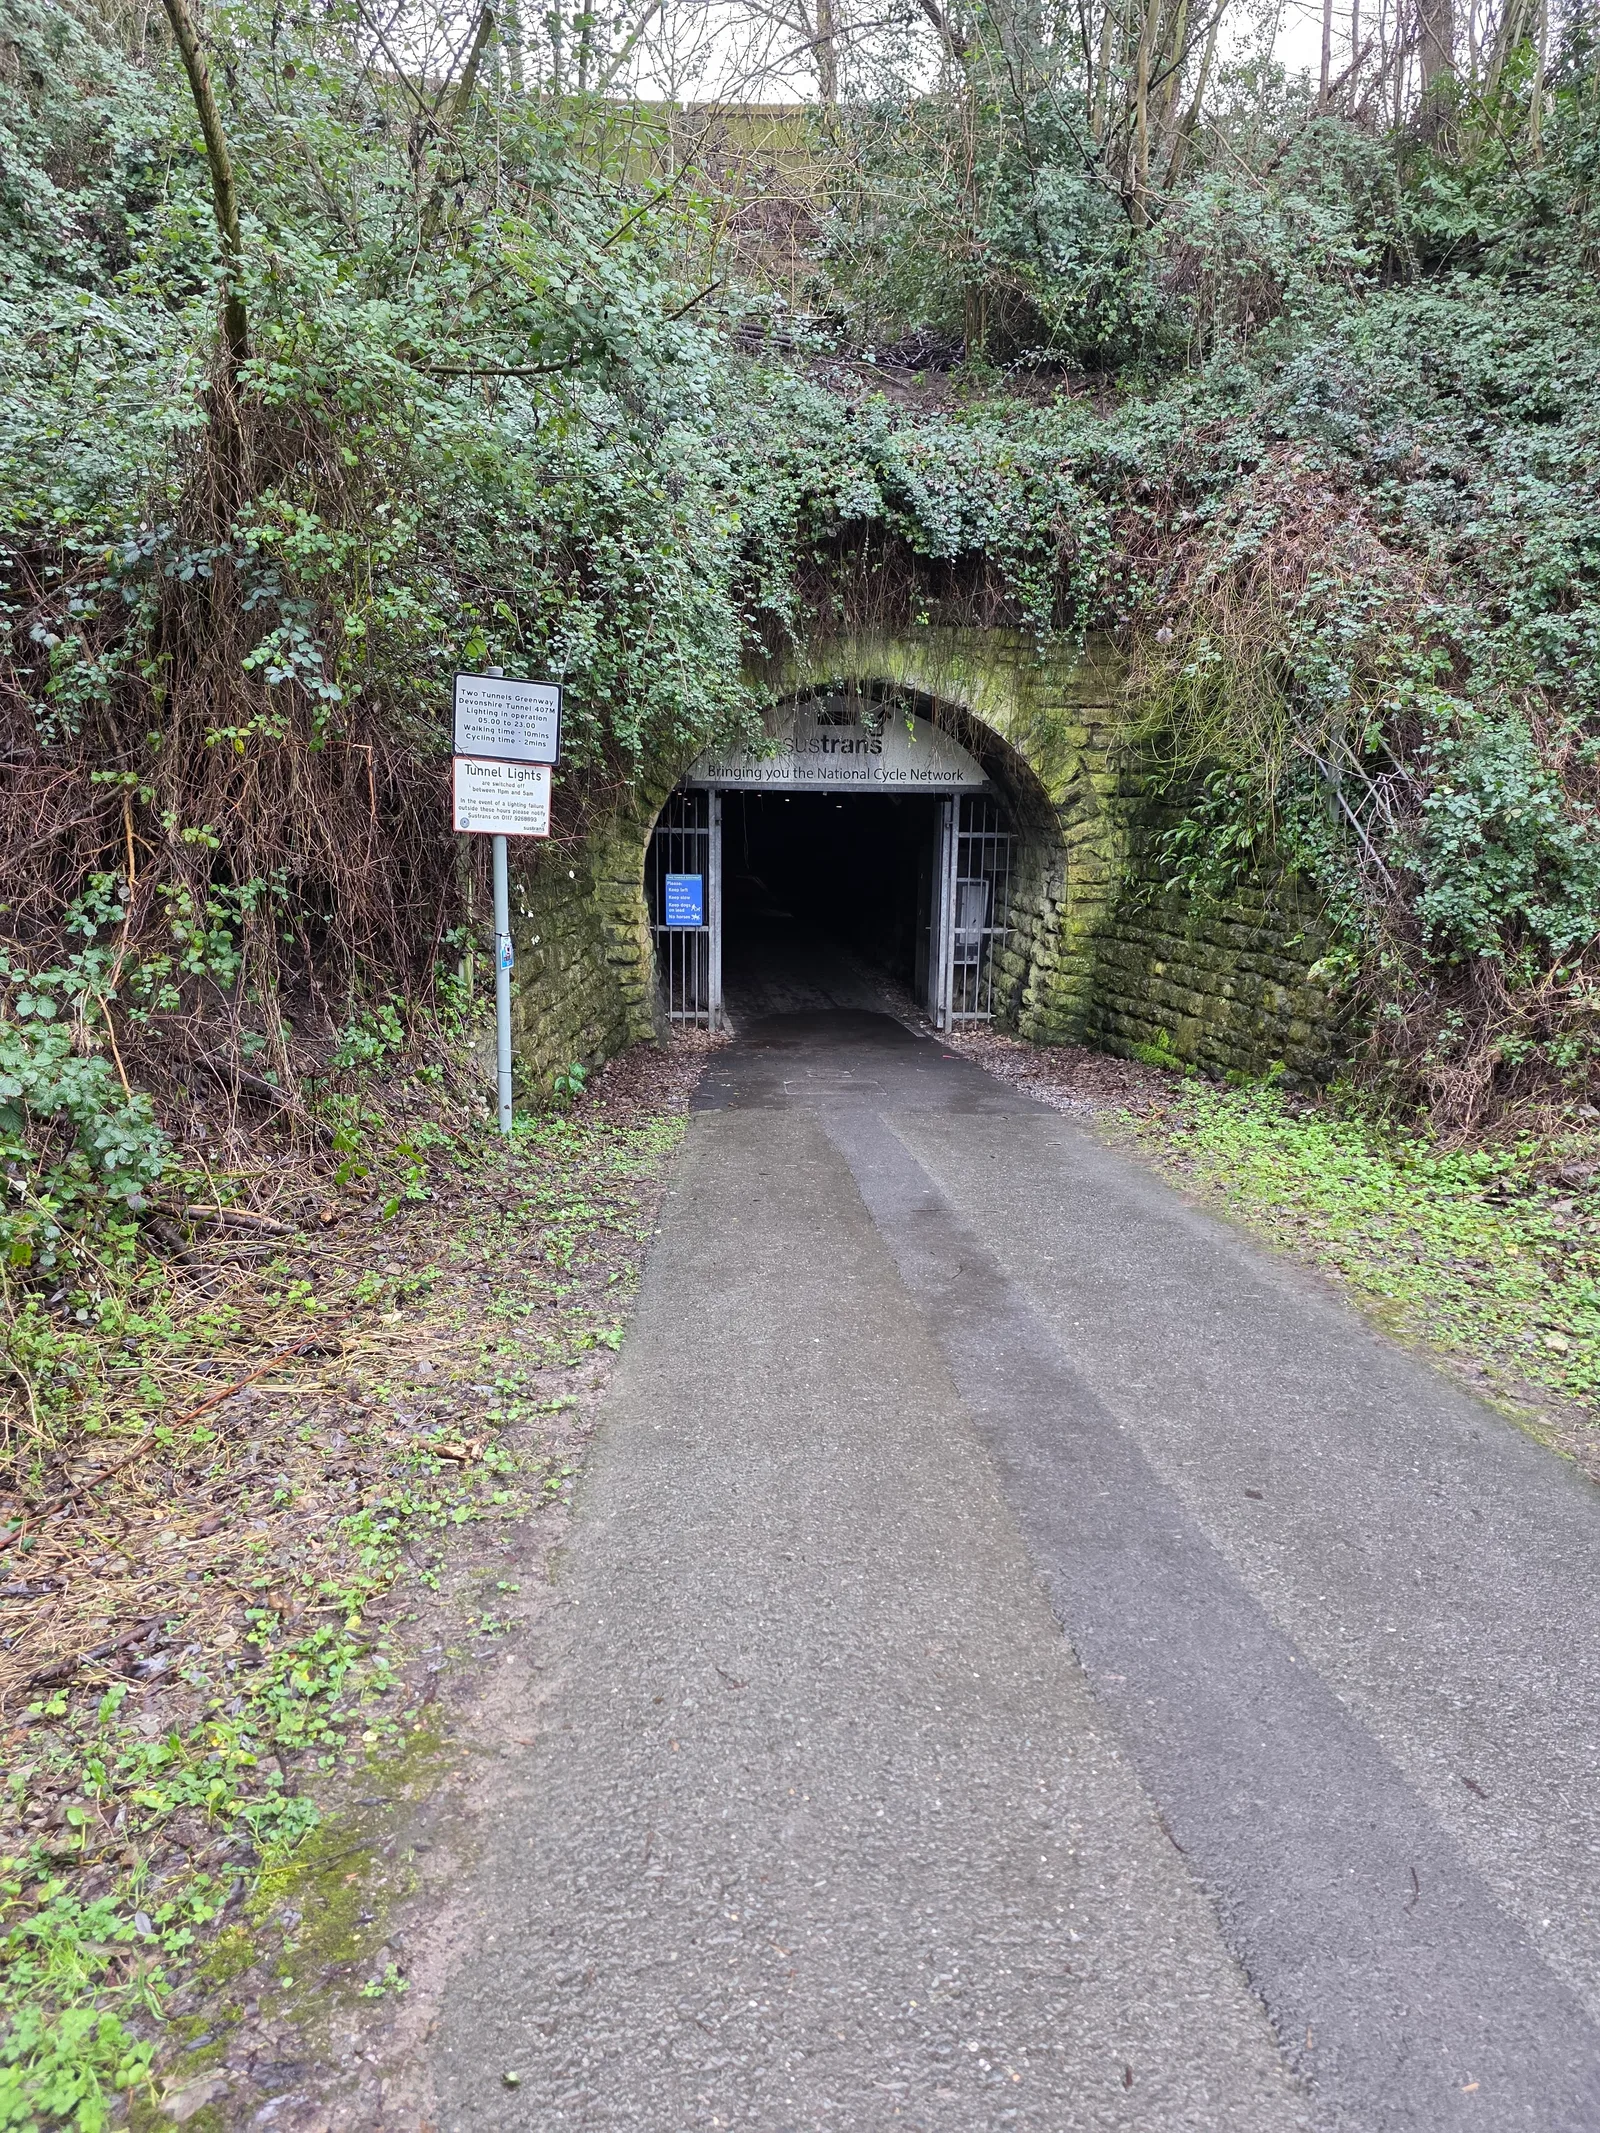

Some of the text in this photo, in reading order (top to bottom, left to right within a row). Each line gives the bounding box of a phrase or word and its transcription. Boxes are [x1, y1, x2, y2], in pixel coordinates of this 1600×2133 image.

[458, 698, 502, 708] Devonshire
[506, 702, 532, 711] Tunnel
[482, 691, 512, 700] Tunnels
[514, 696, 554, 706] Greenway
[466, 707, 498, 717] Lighting
[511, 713, 548, 721] operation
[464, 724, 495, 734] Walking
[524, 730, 549, 739] 10mins
[466, 733, 495, 743] Cycling
[784, 734, 882, 754] sustrans
[465, 764, 542, 782] Tunnel Lights
[708, 765, 964, 782] Bringing you the National Cycle Network
